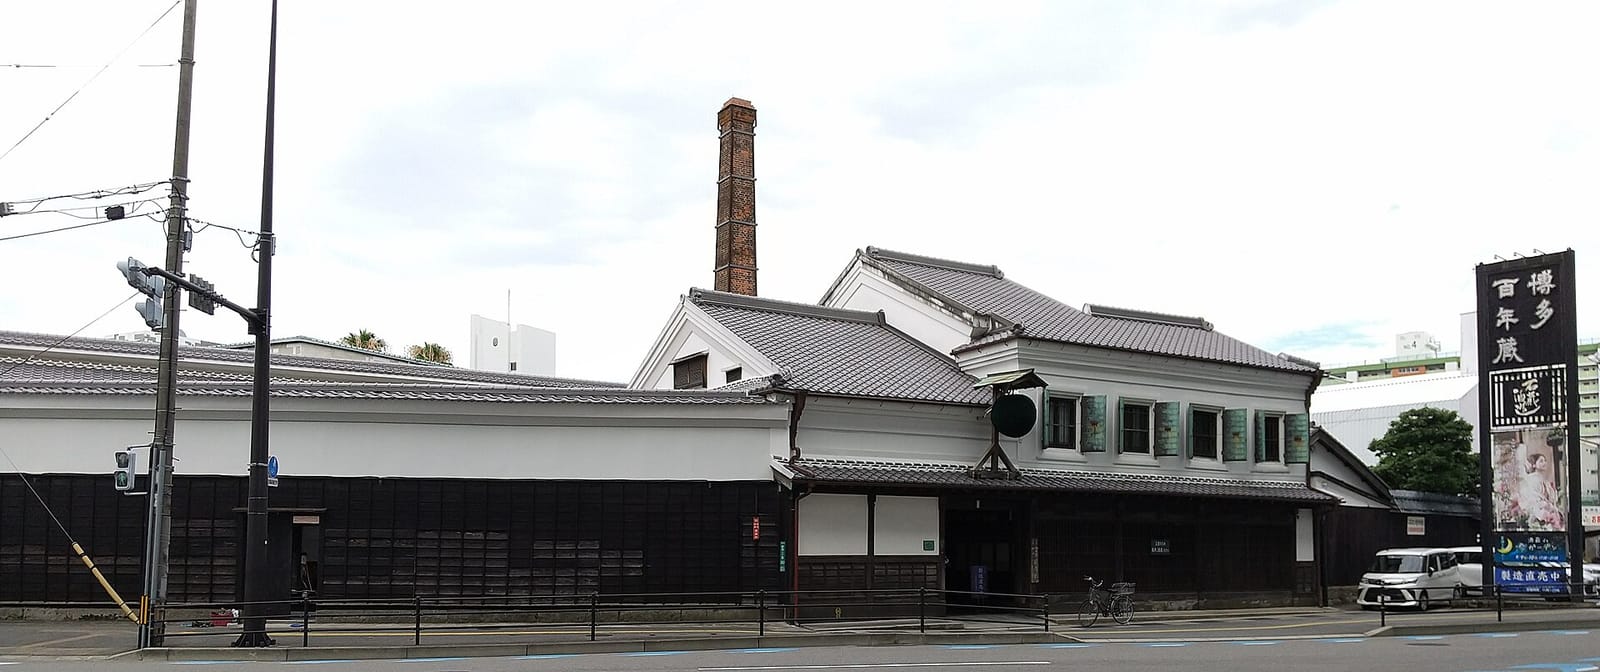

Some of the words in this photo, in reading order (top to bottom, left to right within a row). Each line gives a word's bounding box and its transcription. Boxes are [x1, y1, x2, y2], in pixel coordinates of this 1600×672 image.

[1491, 277, 1524, 365] 百年蔵
[1526, 269, 1557, 330] 博多
